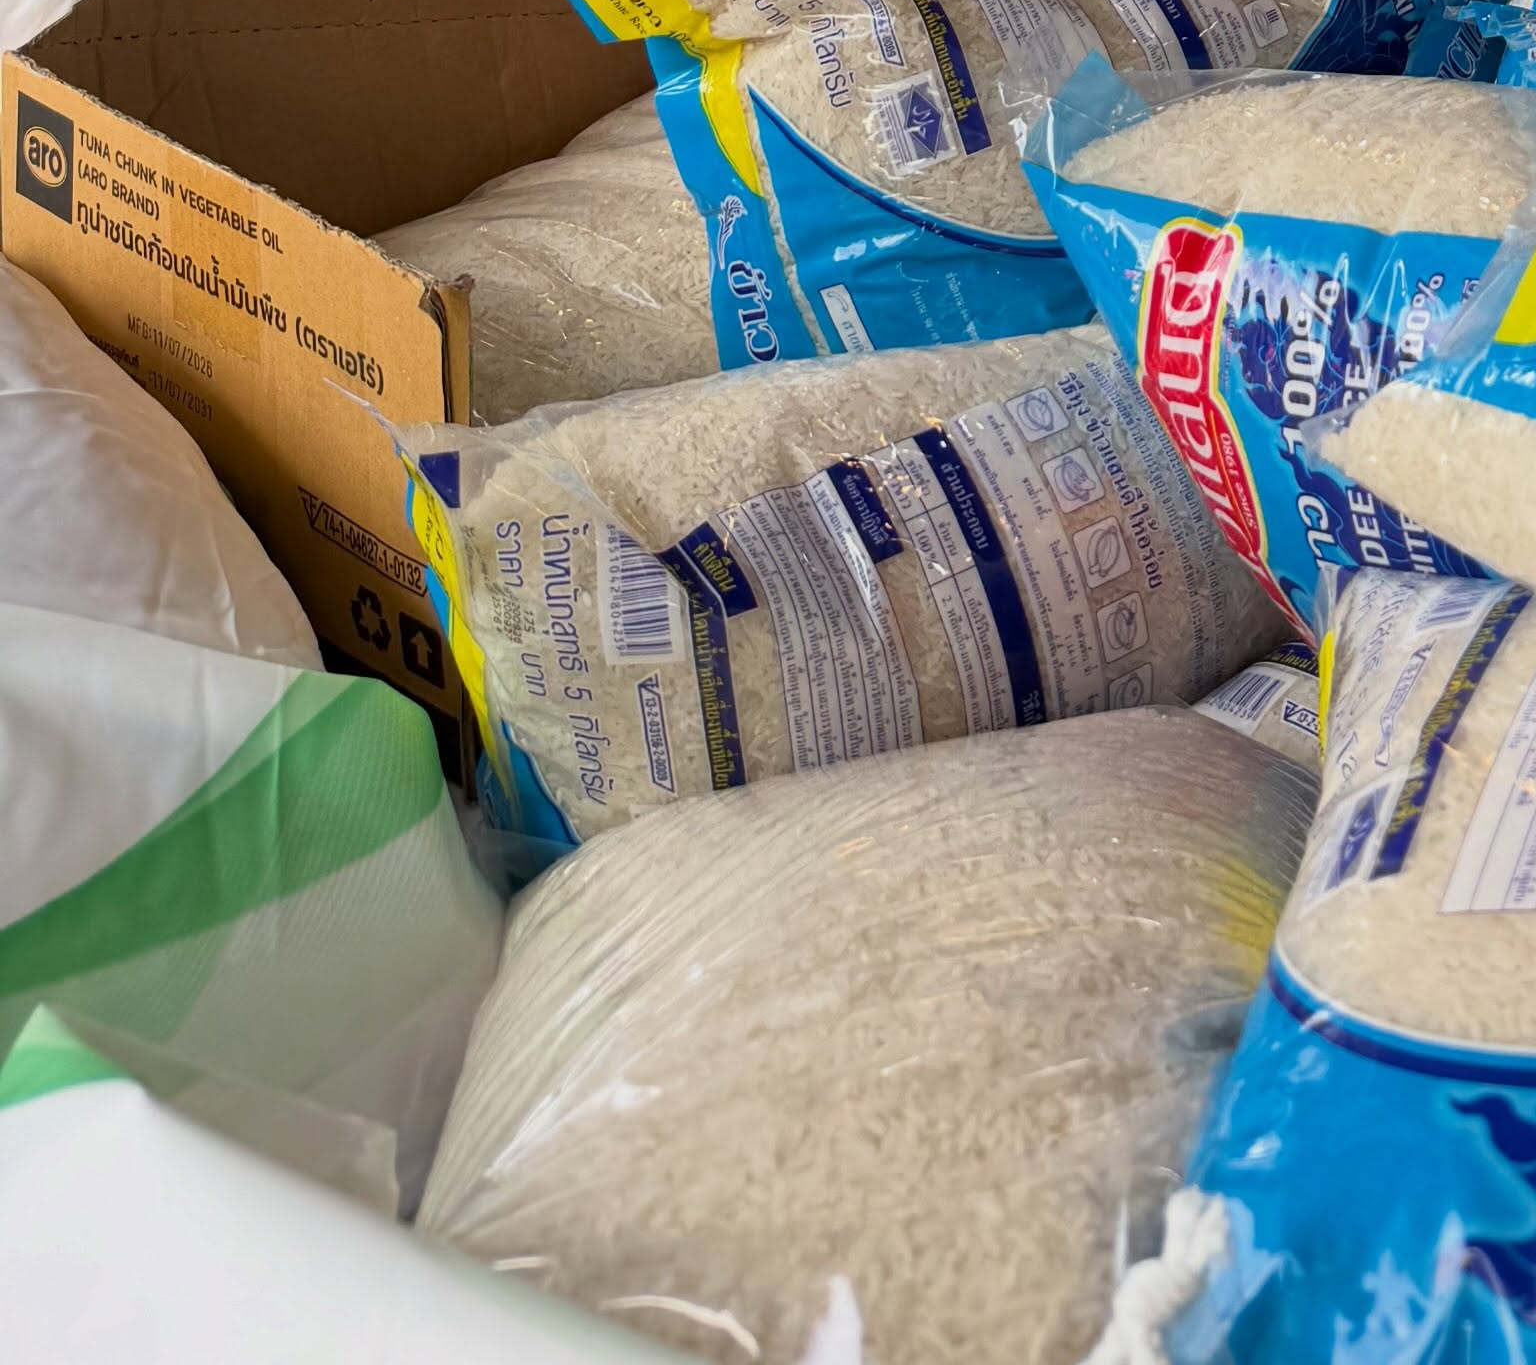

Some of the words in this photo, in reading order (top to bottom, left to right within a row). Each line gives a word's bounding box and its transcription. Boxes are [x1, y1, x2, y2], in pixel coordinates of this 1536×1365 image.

[627, 14, 649, 38] Rice
[808, 12, 860, 112] กิโลกรัม
[28, 134, 63, 180] aro
[78, 159, 107, 191] (ARO
[112, 181, 160, 221] BRAND)
[79, 129, 110, 161] TUNA
[115, 150, 157, 188] CHUNK
[162, 176, 174, 198] IN
[179, 185, 257, 239] VEGETABLE
[262, 227, 283, 254] OIL
[77, 200, 287, 334] ทูน่าชนิดก้อนในน้ำมันพืช
[295, 316, 385, 396] (ตราเอโร่)
[1279, 279, 1341, 455] 100%
[1055, 371, 1097, 417] วิธีหุง
[1082, 416, 1145, 509] ข้าวแสนดี
[1123, 503, 1166, 590] ให้อร่อย
[1219, 433, 1239, 477] 1980
[937, 519, 961, 557] จำนวน
[938, 459, 993, 552] ส่วนประกอบ
[1234, 482, 1258, 528] Since
[323, 507, 422, 591] 74-1-04627-1-0132
[494, 519, 532, 591] ราคา
[690, 541, 737, 594] คำเตือน
[521, 607, 537, 634] 175
[538, 511, 590, 672] น้ำหนักสุทธิ
[519, 650, 549, 700] บาท
[563, 682, 593, 704] 5
[569, 710, 609, 805] กิโลกรัม
[642, 695, 669, 782] 13-2-03156-2-0009
